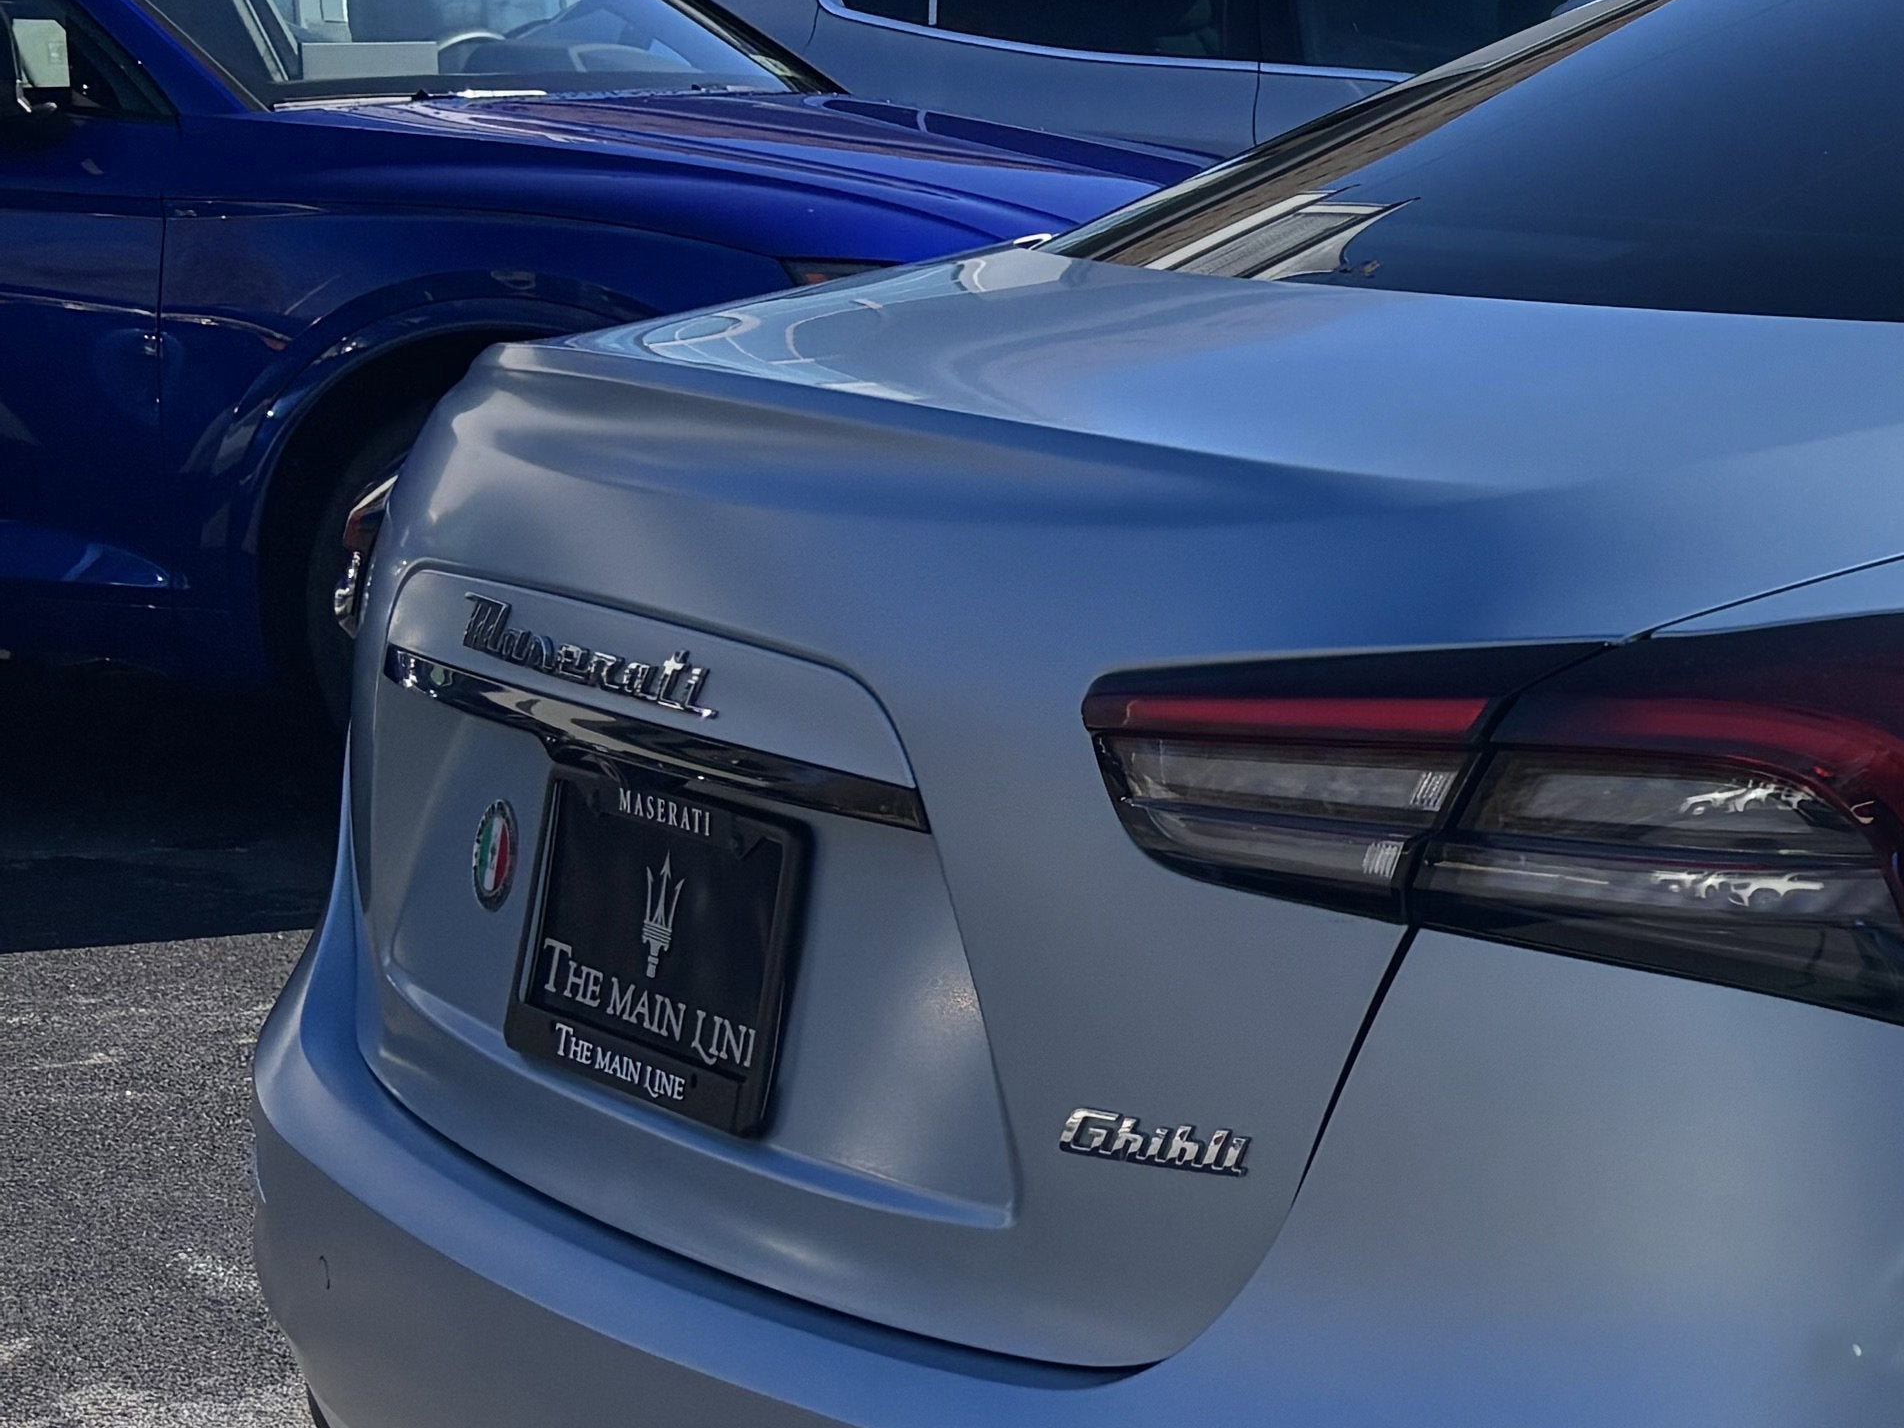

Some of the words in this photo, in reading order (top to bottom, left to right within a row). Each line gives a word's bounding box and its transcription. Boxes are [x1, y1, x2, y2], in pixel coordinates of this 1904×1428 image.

[463, 591, 720, 719] Maserati
[618, 787, 710, 837] MASERATI
[543, 937, 604, 1008] THE
[606, 976, 687, 1042] MAIN
[555, 1022, 594, 1066] THE
[594, 1046, 643, 1085] MAIN
[643, 1065, 687, 1101] LINE
[1058, 1107, 1252, 1178] Ghibli
